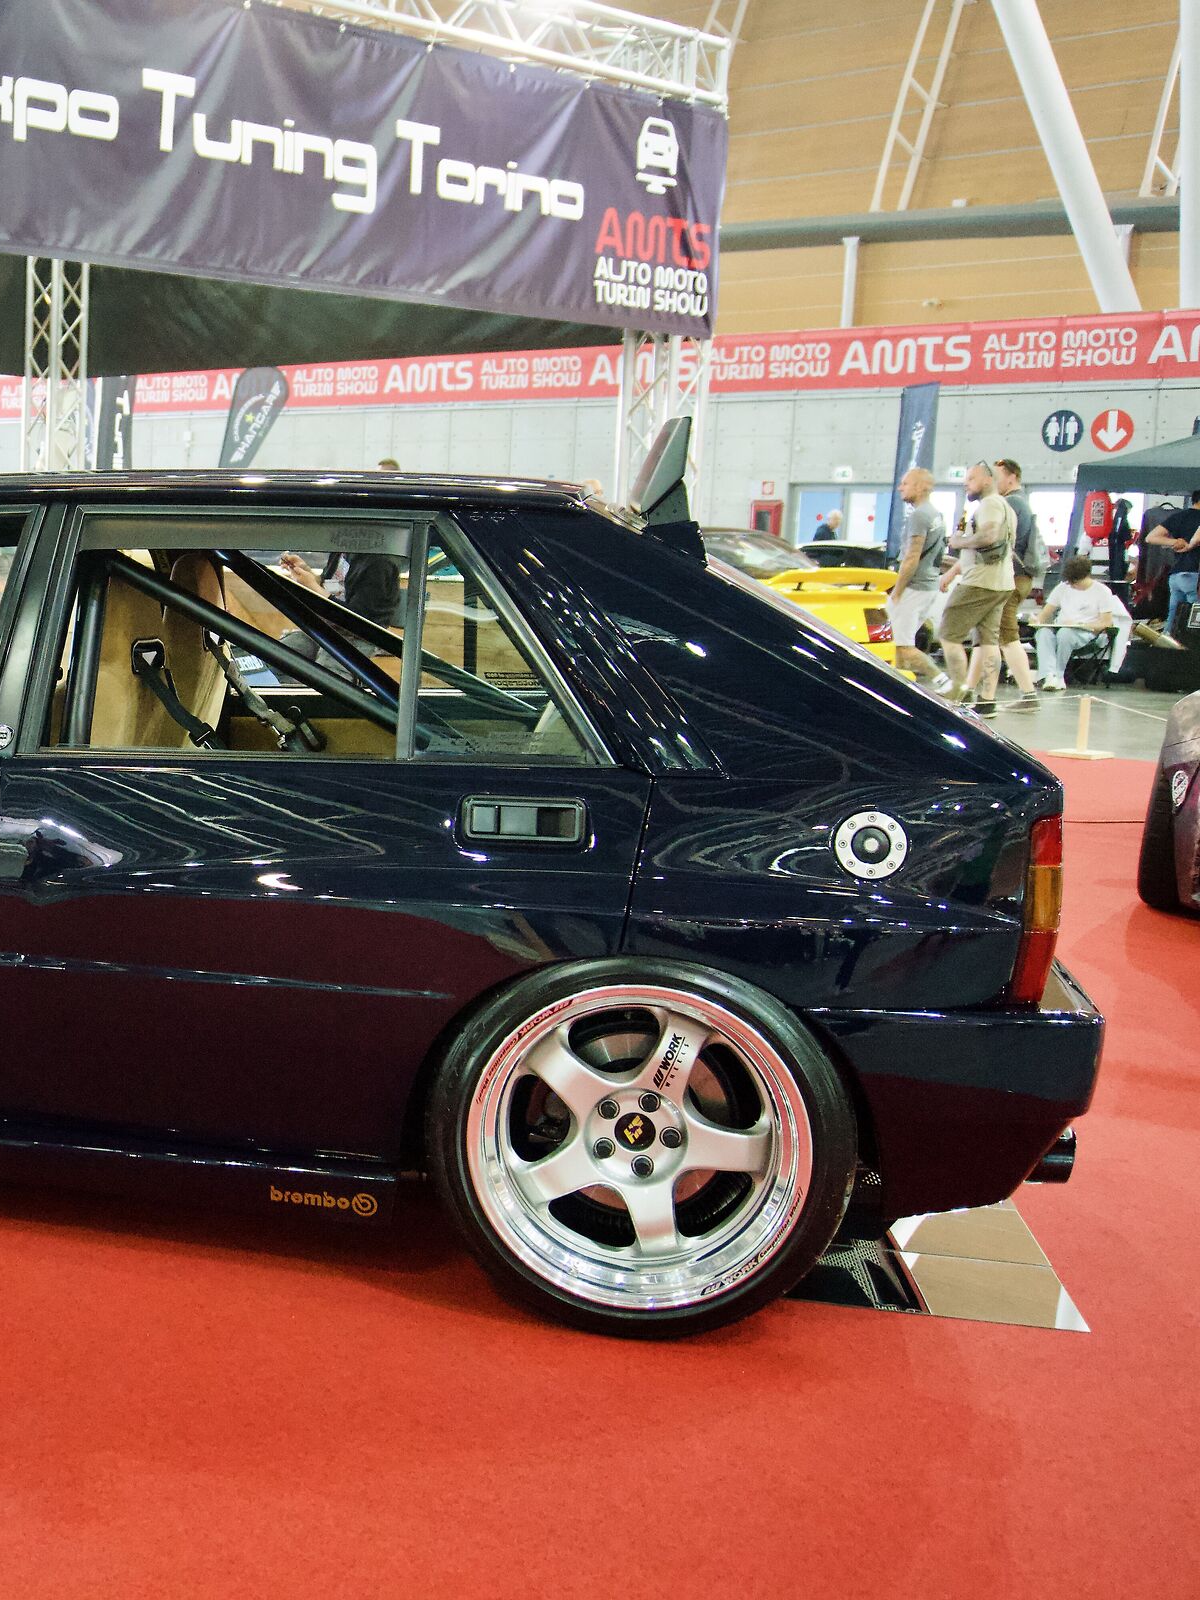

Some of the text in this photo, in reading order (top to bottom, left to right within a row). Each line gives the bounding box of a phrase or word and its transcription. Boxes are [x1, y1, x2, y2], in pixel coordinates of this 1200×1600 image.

[142, 68, 377, 214] Tuning
[396, 119, 583, 220] Torino
[595, 207, 711, 270] AMTS
[594, 256, 708, 294] AUTO MOTO
[593, 280, 709, 318] TURIN SHOW
[984, 332, 1057, 352] AUTO
[1061, 327, 1138, 348] MOTO
[481, 356, 582, 373] AUTO MOTO
[708, 342, 831, 364] AUTO MOTO
[839, 335, 972, 376] AMTS
[982, 346, 1137, 371] TURIN SHOW
[135, 376, 170, 389] AUTO
[171, 374, 208, 388] MOTO
[293, 365, 379, 383] AUTO MOTO
[383, 360, 474, 394] AMTS
[480, 370, 582, 390] TURIN SHOW
[708, 359, 830, 381] TURIN SHOW
[134, 387, 208, 403] TURIN SHOW
[293, 380, 379, 398] TURIN SHOW
[659, 1033, 682, 1071] WORK
[270, 1185, 350, 1210] brembo
